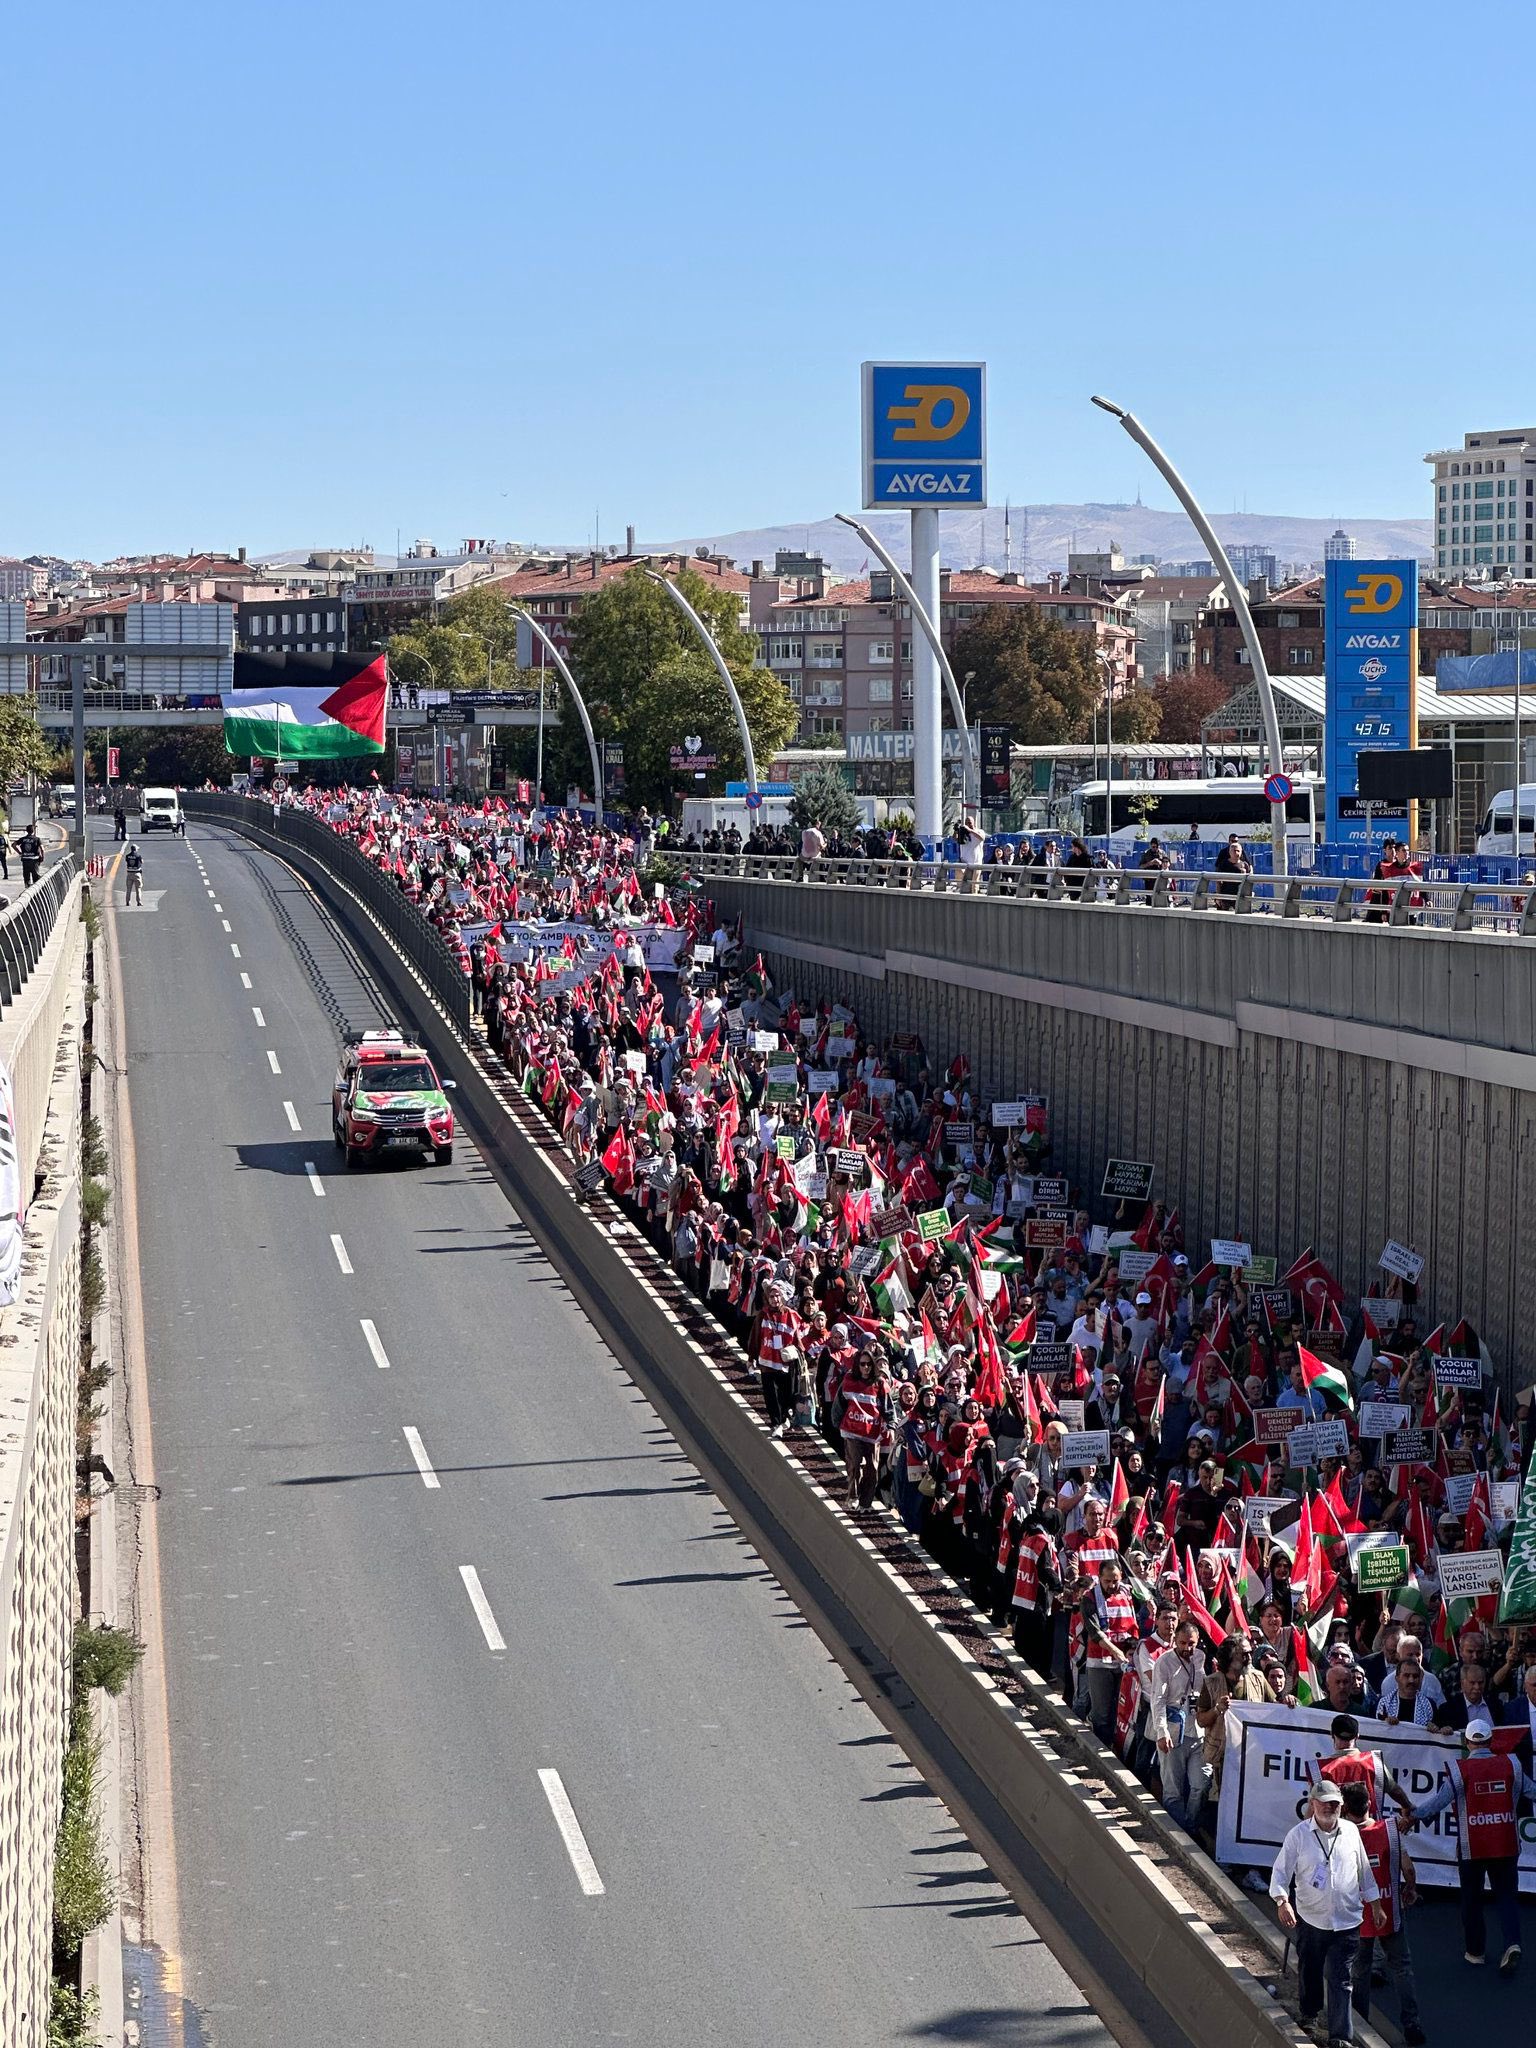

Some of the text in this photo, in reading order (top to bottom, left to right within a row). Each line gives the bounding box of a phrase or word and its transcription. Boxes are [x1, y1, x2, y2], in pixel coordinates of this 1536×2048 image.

[886, 474, 971, 493] AYGAZ
[1346, 635, 1401, 648] AYGAZ
[1359, 666, 1386, 674] FUCHS
[850, 734, 914, 758] MALTEP
[1343, 809, 1378, 817] ÇEKİRDK
[1349, 831, 1397, 840] matepe
[841, 1152, 863, 1160] ÇOCUK
[840, 1158, 864, 1167] HAKLARI
[1116, 1163, 1145, 1173] SUSMA
[1114, 1170, 1144, 1180] HAYKIR
[1105, 1177, 1149, 1188] SOYKIRIMA
[1114, 1186, 1138, 1194] HAYIR
[1254, 1294, 1284, 1303] ÇCUK
[1036, 1346, 1066, 1356] ÇOCUK
[1032, 1354, 1068, 1363] HAKLARI
[1440, 1360, 1473, 1368] ÇOCUK
[1437, 1368, 1476, 1376] HAKLARI
[1261, 1411, 1297, 1419] NEHİRDEN
[1267, 1417, 1292, 1425] DENİZE
[1268, 1424, 1293, 1432] ÖZGÜR
[1260, 1431, 1287, 1440] FİLİSTİ
[1066, 1443, 1104, 1452] GENÇLERİN
[1386, 1452, 1421, 1460] NEREDE?
[1252, 1509, 1264, 1519] IS
[1372, 1551, 1394, 1559] İSLAM
[1367, 1556, 1400, 1569] İŞBİRLİĞİ
[1367, 1566, 1401, 1577] TEŞKİLATI
[1443, 1562, 1499, 1574] SOYKIRIMCILAR
[1444, 1573, 1482, 1582] YARGI-
[1446, 1580, 1488, 1592] LANSIN!
